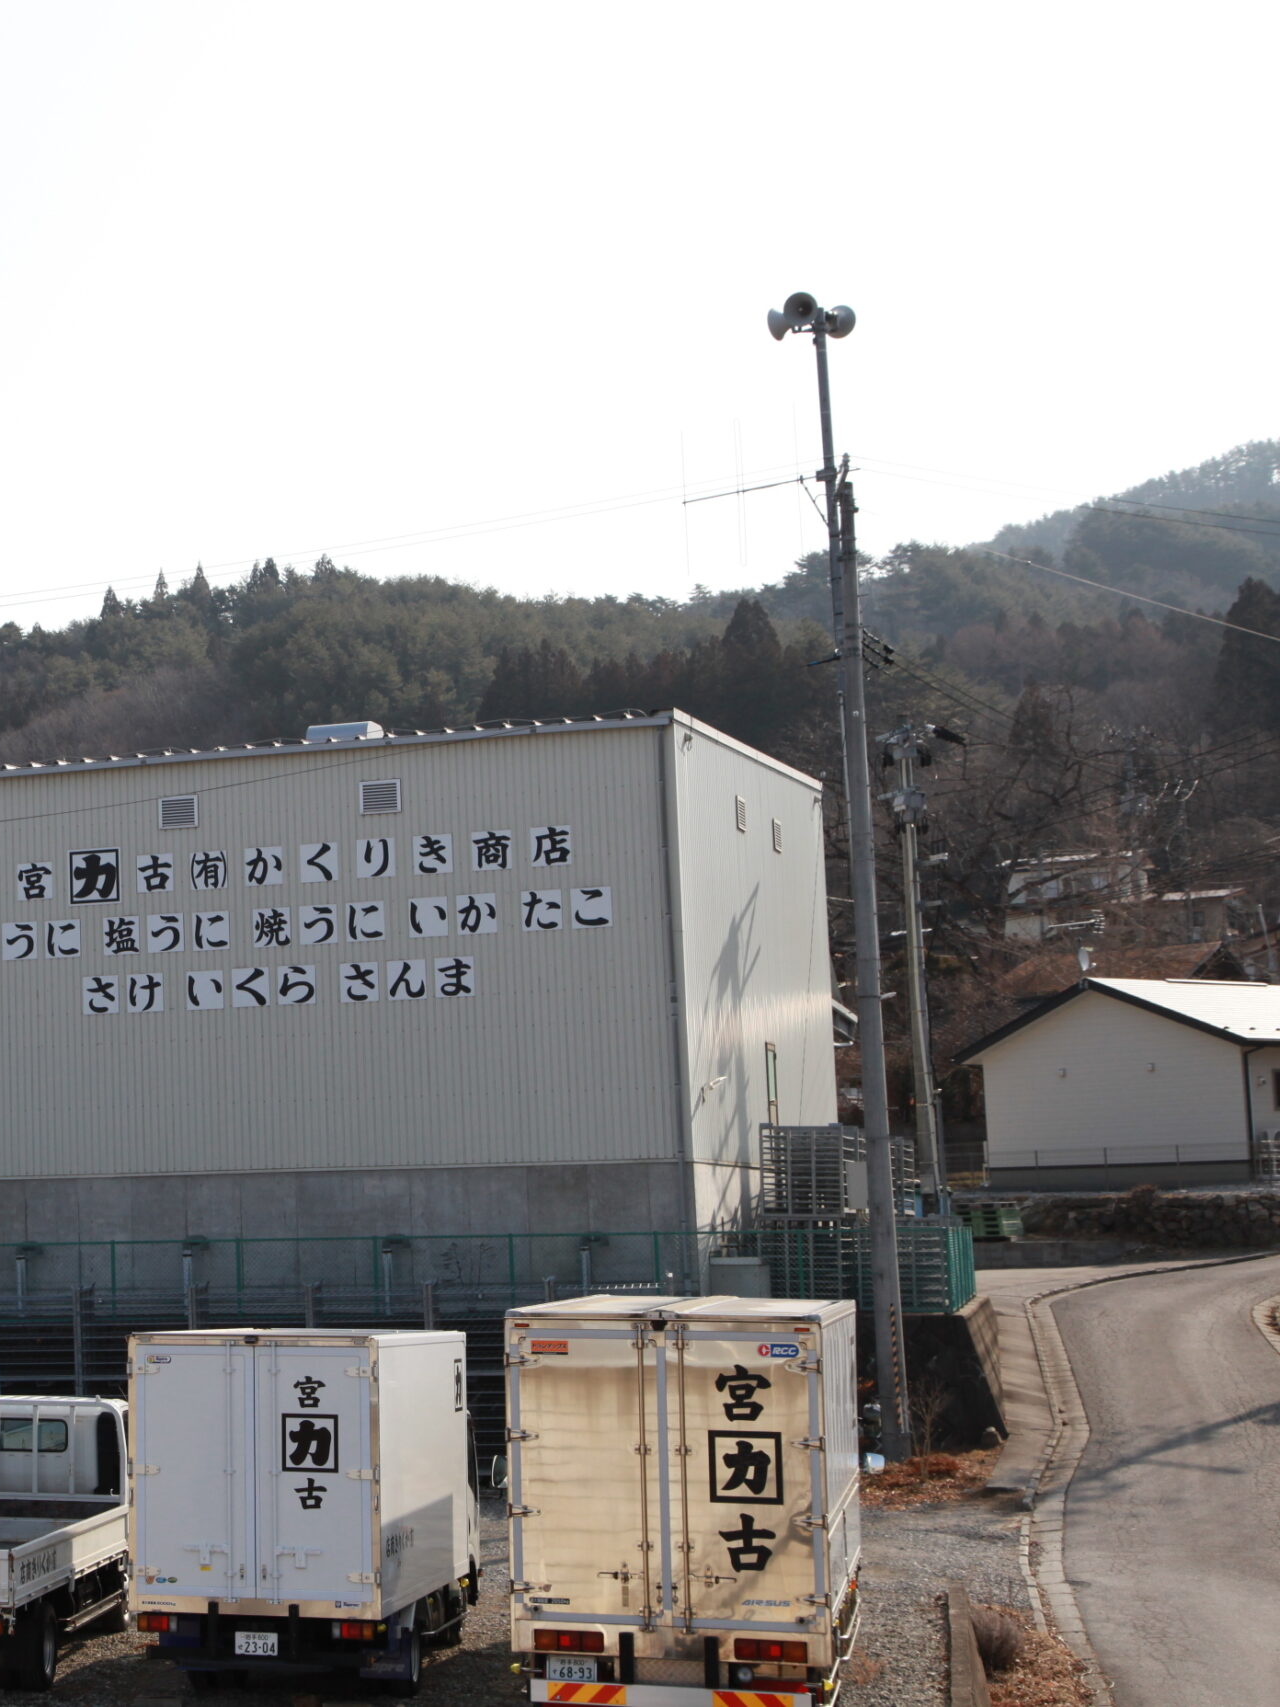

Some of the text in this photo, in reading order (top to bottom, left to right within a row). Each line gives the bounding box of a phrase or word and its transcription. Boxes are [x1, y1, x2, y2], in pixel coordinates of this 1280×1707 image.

[105, 912, 228, 954] 塩うに
[255, 907, 383, 947] 焼うに
[411, 896, 496, 934] いか
[524, 889, 609, 929] たこ
[88, 958, 472, 1014] さけ いくら さんま
[773, 1347, 797, 1355] RCC
[560, 1667, 592, 1679] 68-93
